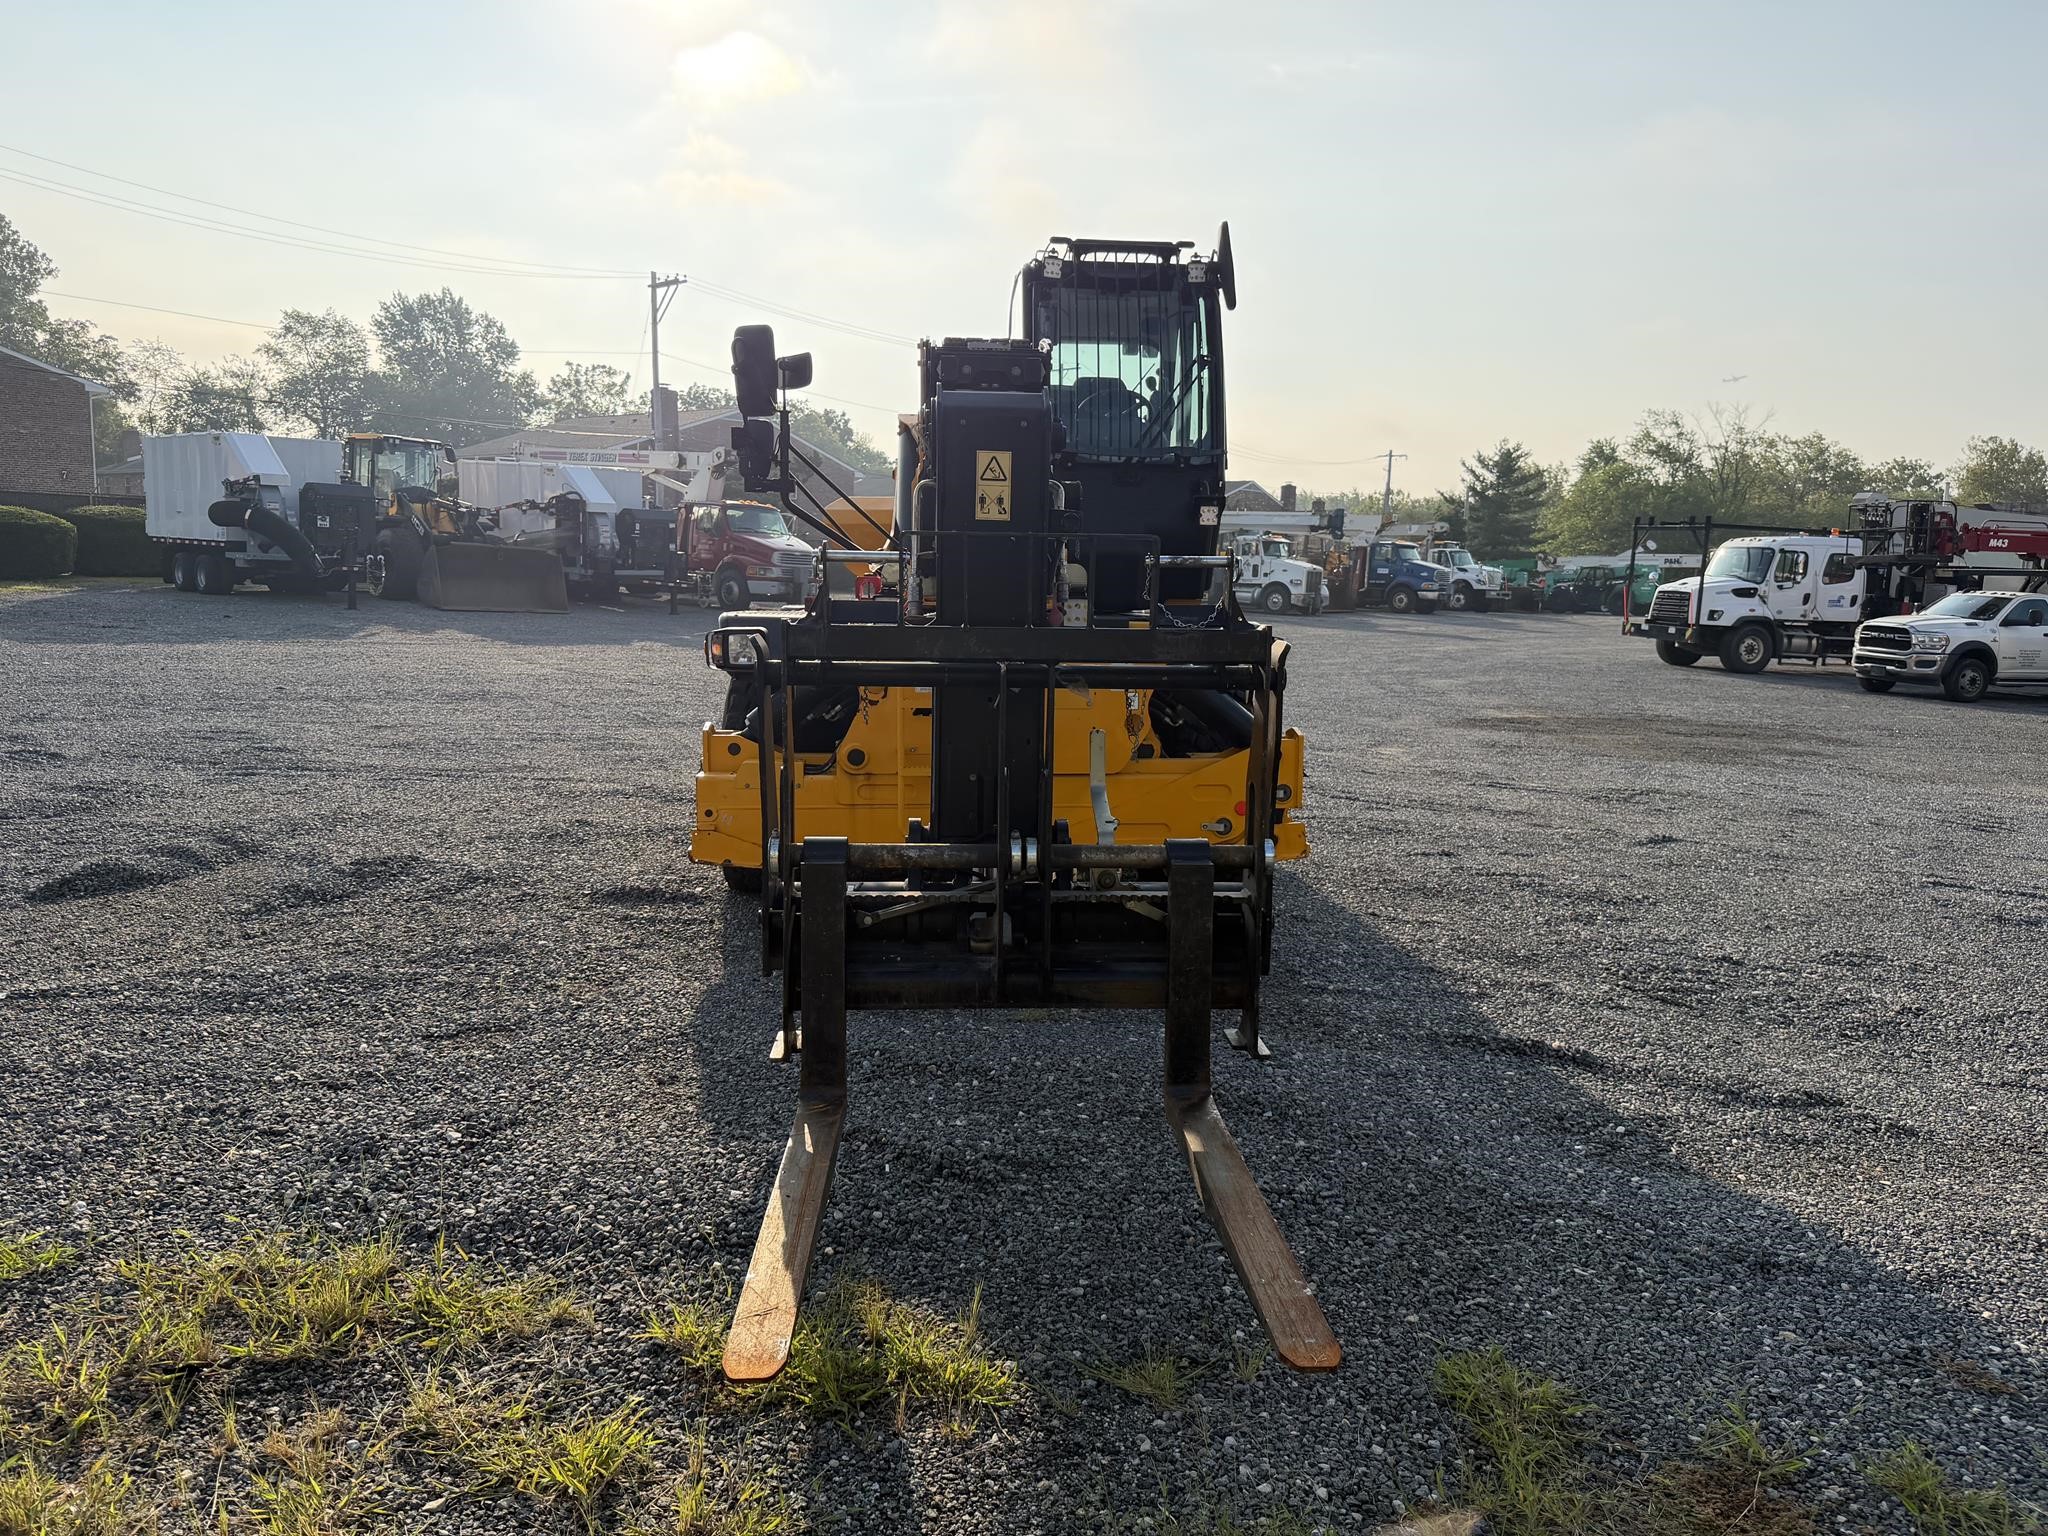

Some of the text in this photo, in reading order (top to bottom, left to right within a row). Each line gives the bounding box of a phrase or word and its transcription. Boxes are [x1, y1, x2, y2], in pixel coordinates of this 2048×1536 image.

[61, 470, 68, 479] 7
[411, 515, 424, 536] JCB
[1988, 538, 2008, 548] M43
